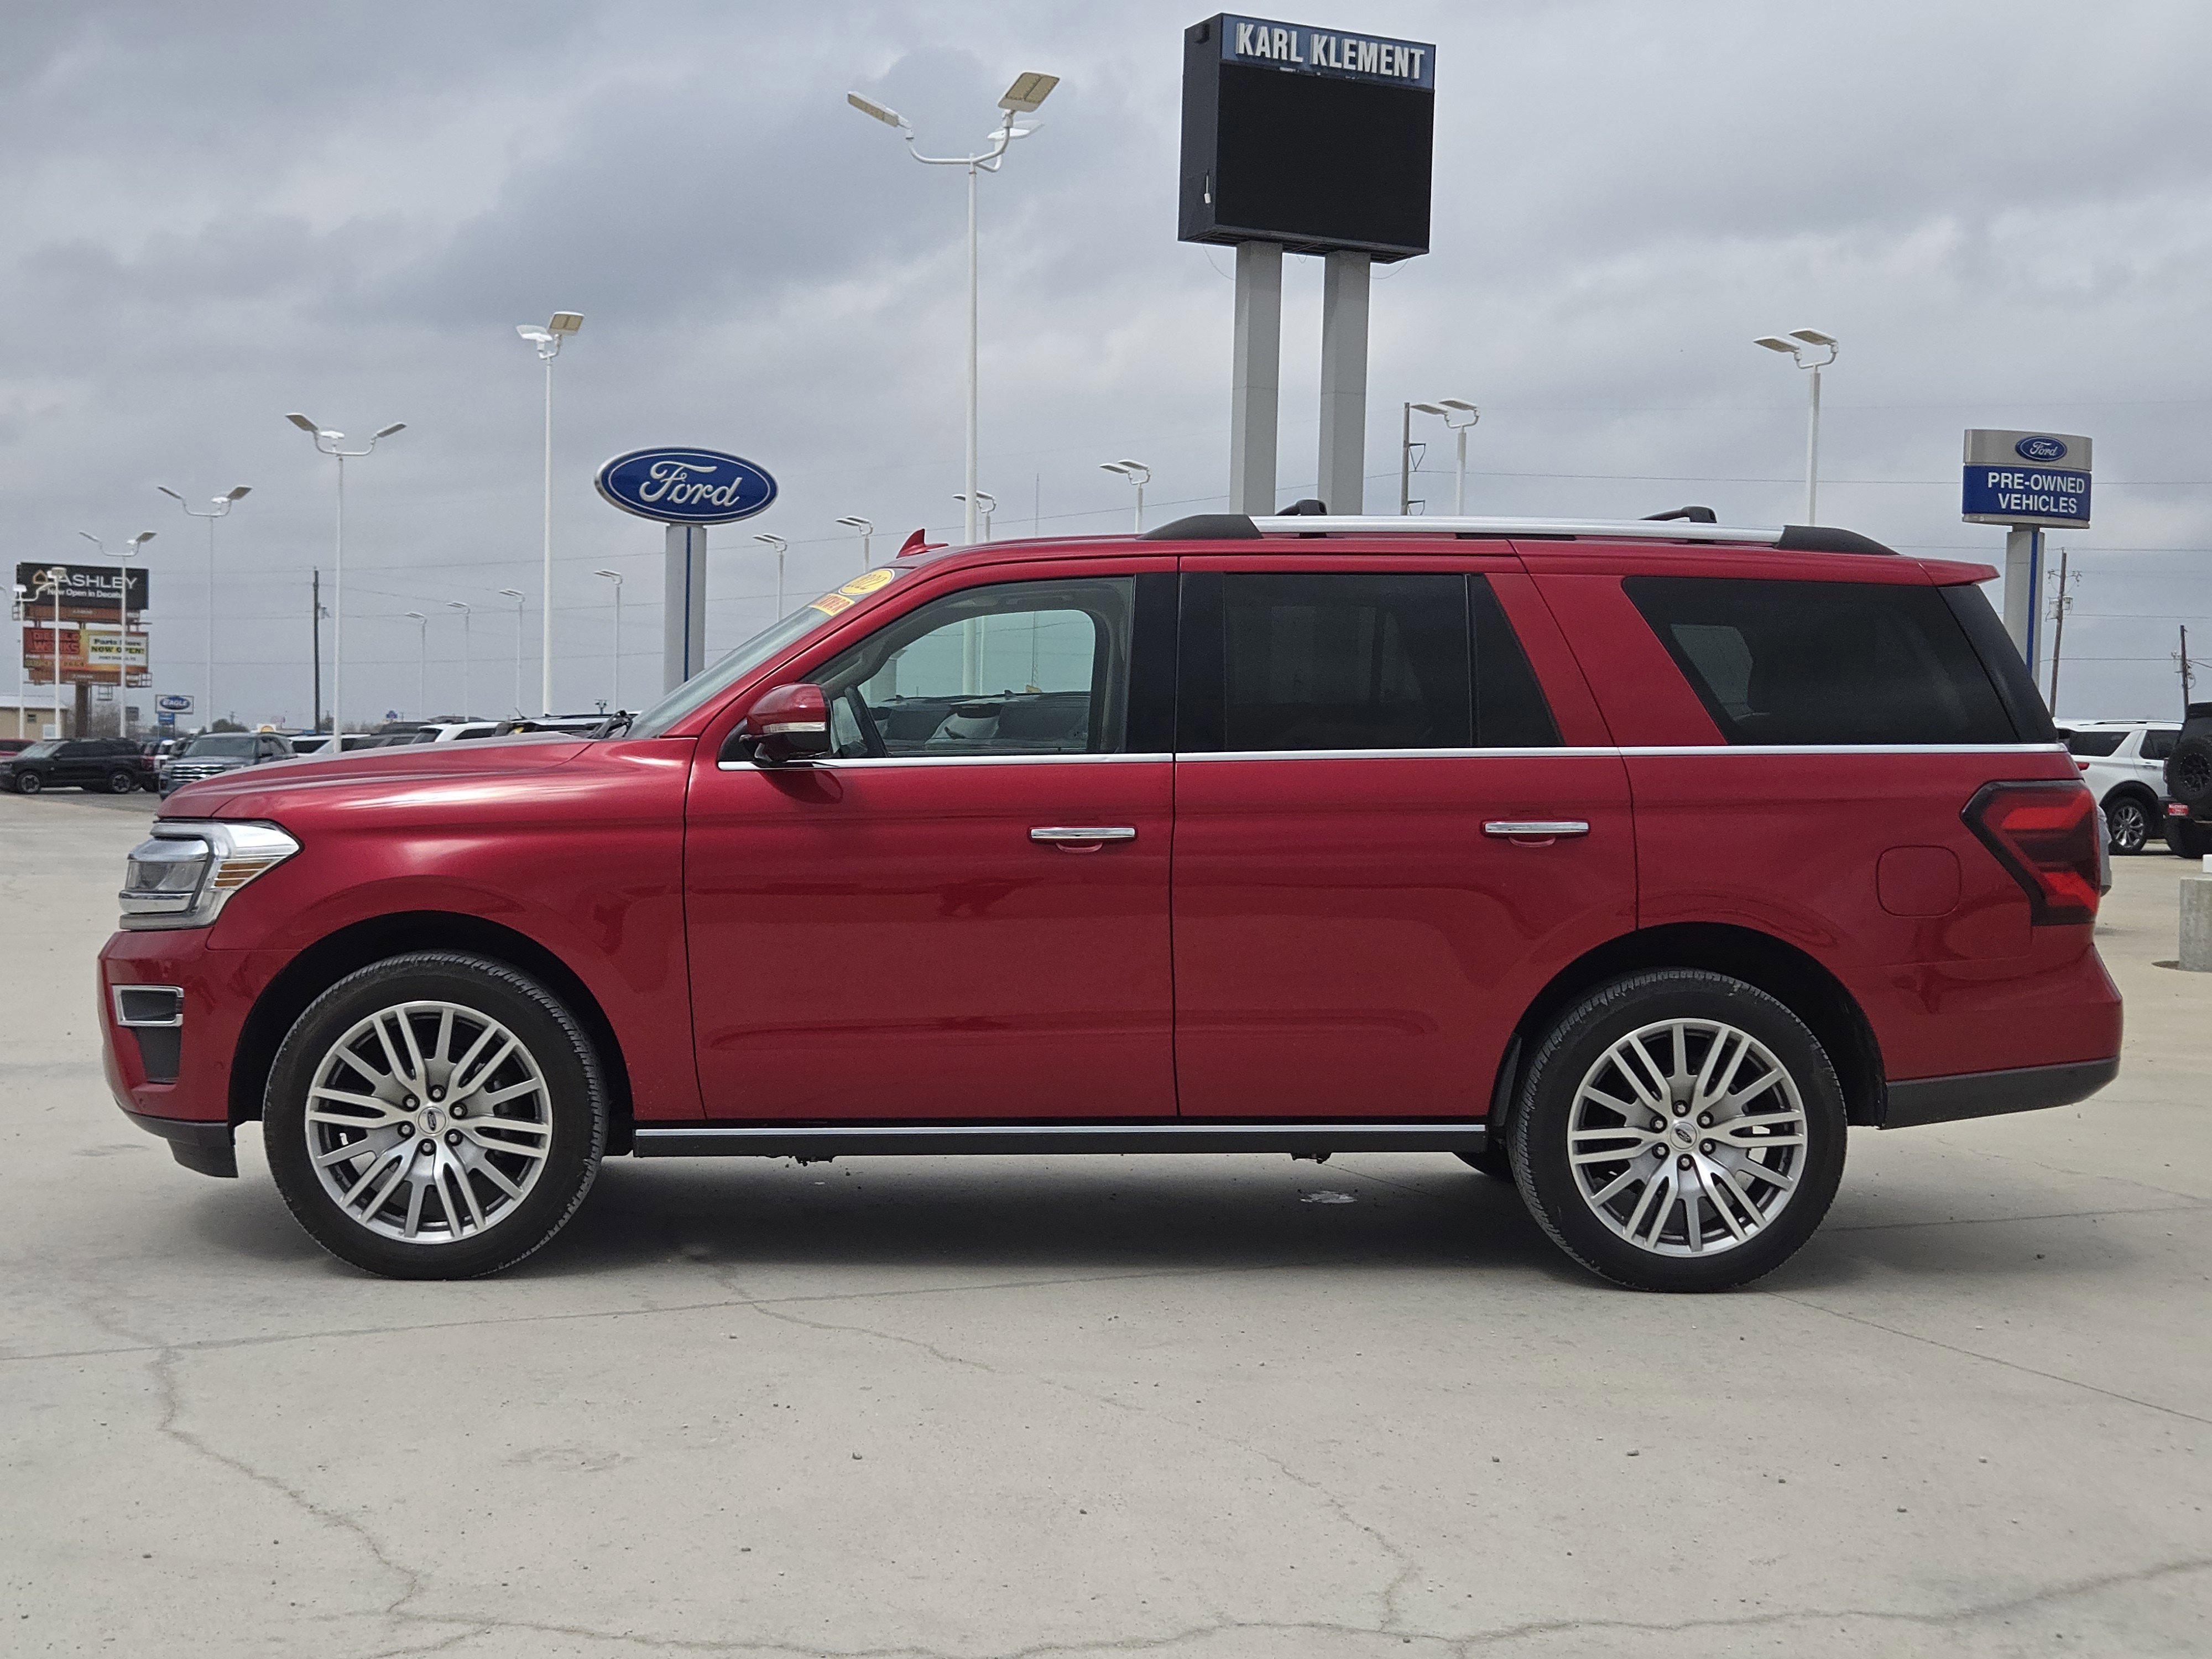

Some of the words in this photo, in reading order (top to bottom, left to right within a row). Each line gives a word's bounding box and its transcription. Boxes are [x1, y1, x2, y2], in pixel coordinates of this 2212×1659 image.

[1235, 23, 1304, 62] KARL
[1310, 34, 1425, 79] KLEMENT
[2029, 441, 2058, 457] Ford
[639, 460, 743, 507] Ford
[1987, 472, 2084, 494] PRE-OWNED
[1998, 493, 2077, 514] VEHICLES
[66, 588, 87, 597] Open
[88, 588, 95, 597] in
